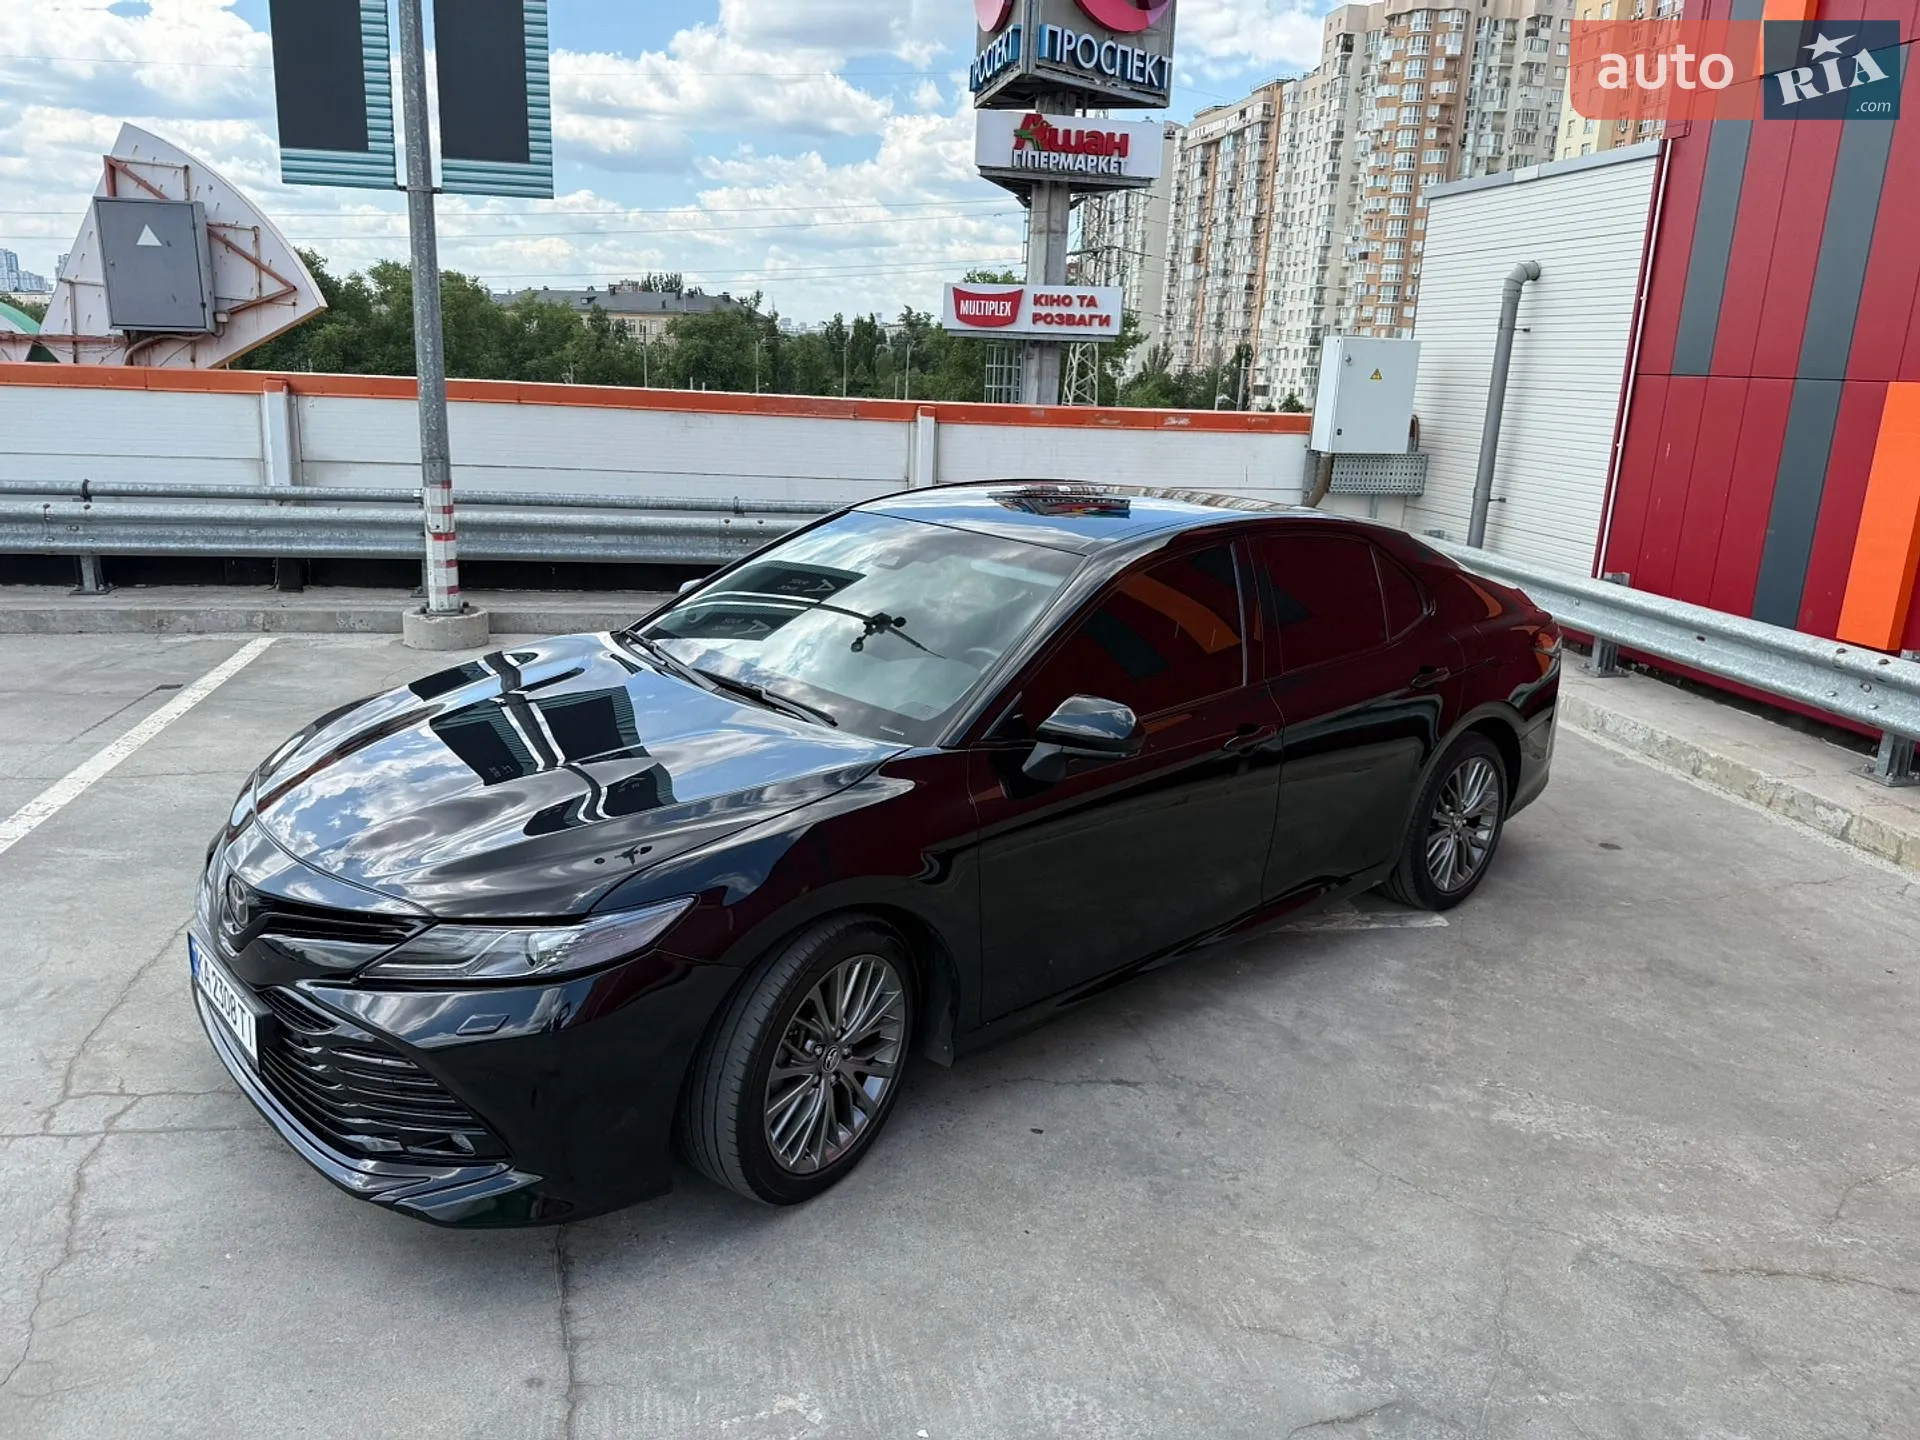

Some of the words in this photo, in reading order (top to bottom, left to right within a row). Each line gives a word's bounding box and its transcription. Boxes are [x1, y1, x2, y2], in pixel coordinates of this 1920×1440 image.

[1038, 24, 1173, 90] ПРОСПЕКТ
[1014, 113, 1129, 157] Ашан
[1012, 149, 1126, 175] ГІПЕРМАРКЕТ
[959, 299, 1012, 317] MULTIPLEX
[1033, 293, 1073, 307] КІНО
[1076, 295, 1098, 308] ТА
[1032, 312, 1111, 327] РОЗВАГИ
